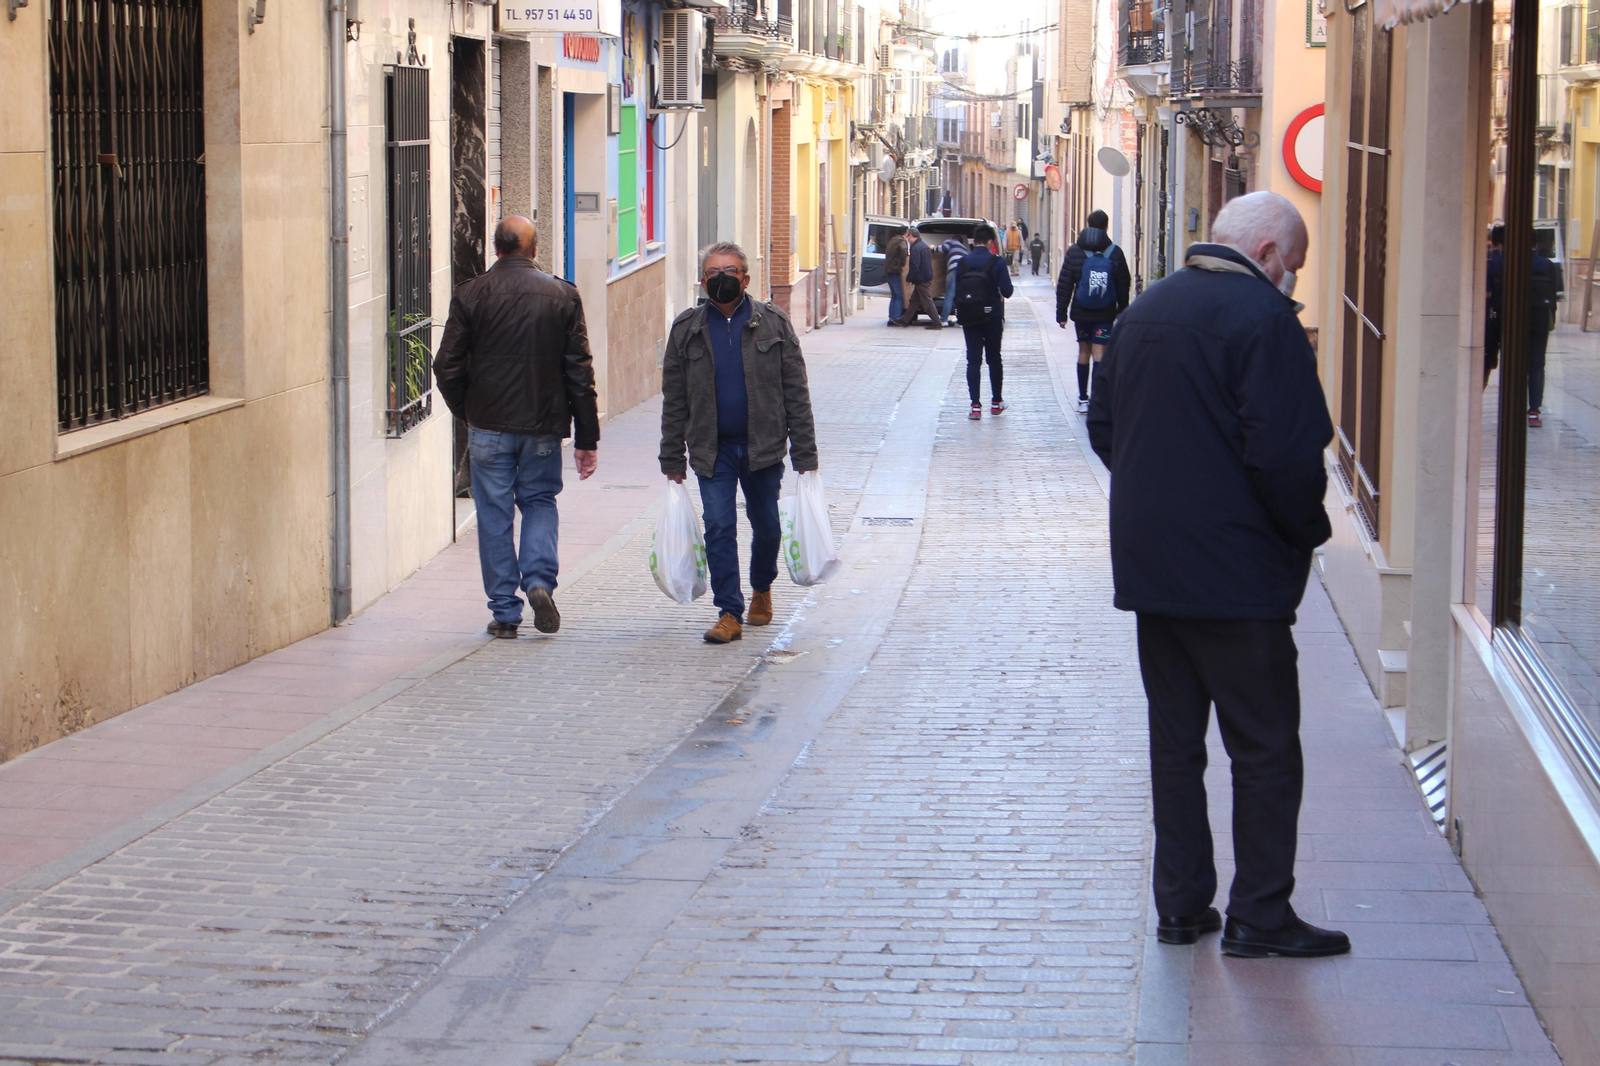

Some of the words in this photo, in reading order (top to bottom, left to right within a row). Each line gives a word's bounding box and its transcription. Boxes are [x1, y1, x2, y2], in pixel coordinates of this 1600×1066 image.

[505, 8, 522, 20] TL.
[525, 8, 544, 20] 957
[547, 8, 559, 20] 51
[563, 8, 576, 20] 44
[579, 8, 593, 20] 50
[1090, 270, 1108, 279] Ree
